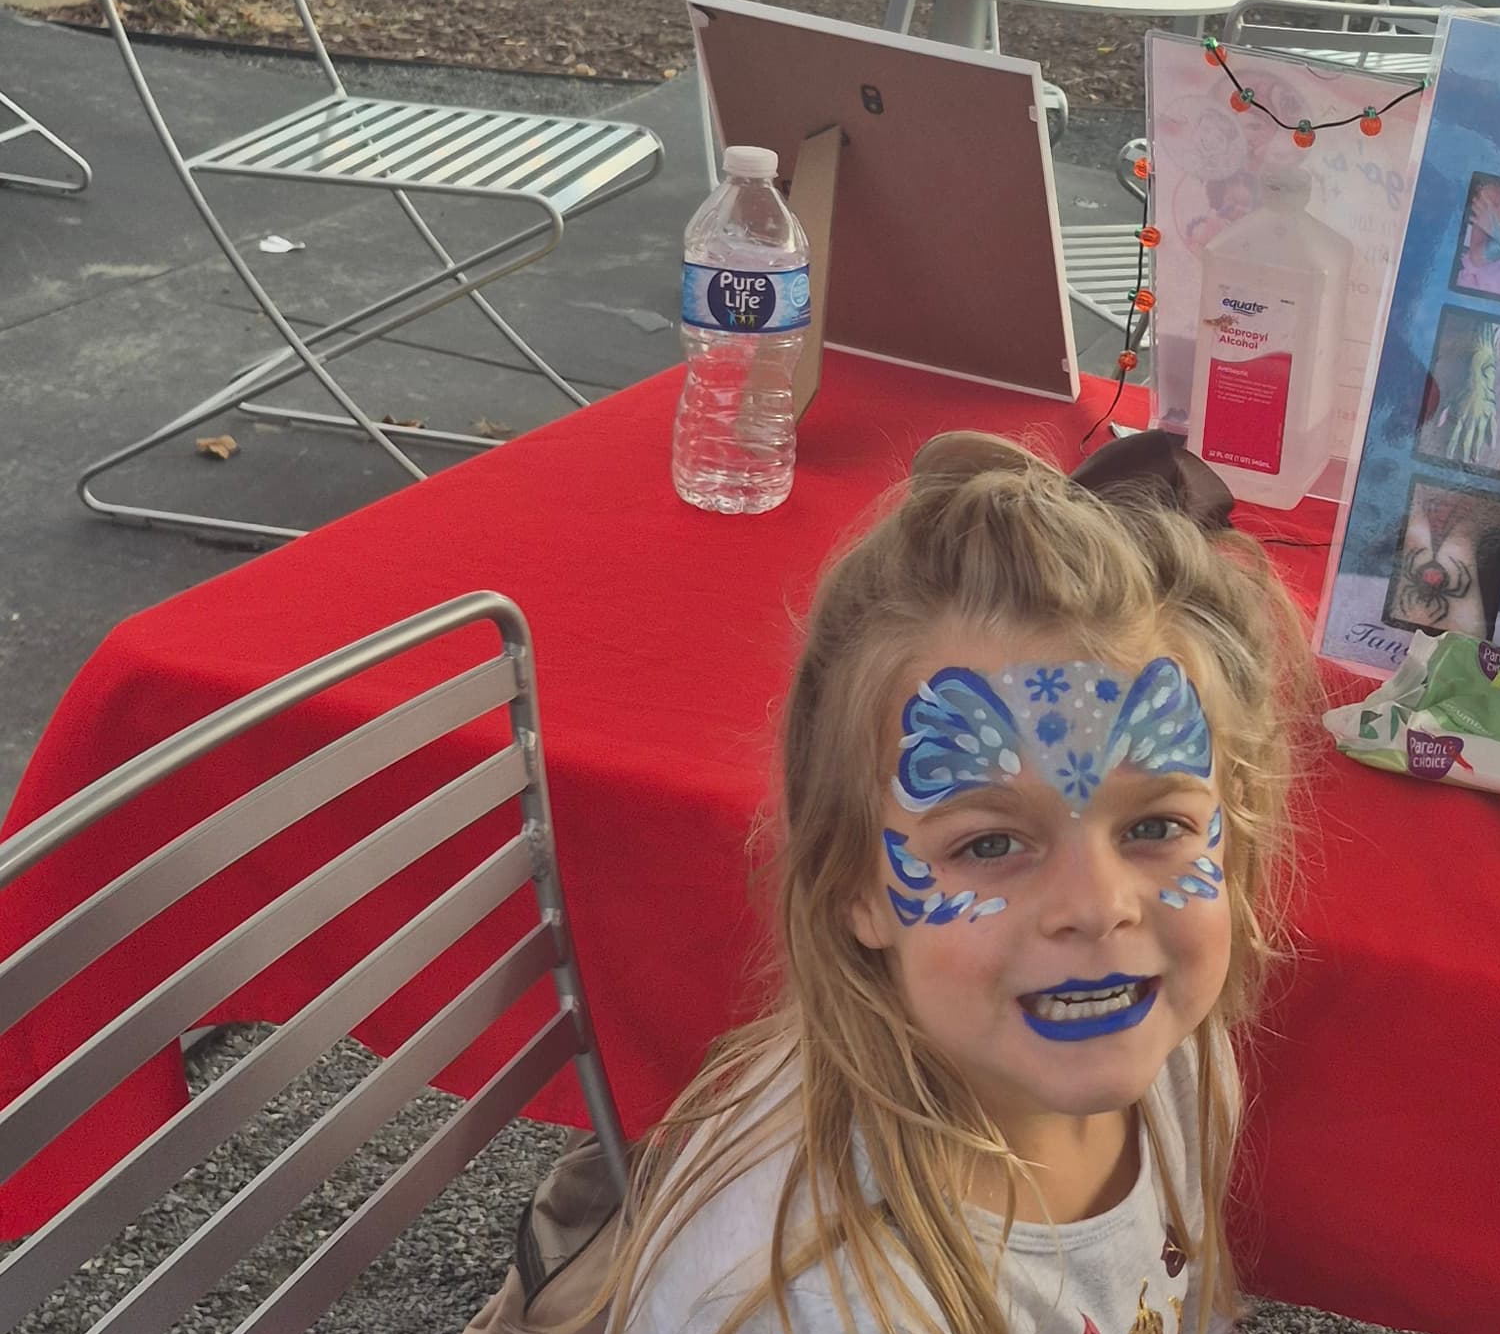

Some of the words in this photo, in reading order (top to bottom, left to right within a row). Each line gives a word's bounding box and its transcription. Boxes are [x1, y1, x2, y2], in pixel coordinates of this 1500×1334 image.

[720, 271, 766, 291] Pure
[724, 290, 760, 312] Life
[1222, 298, 1265, 316] equate
[1219, 335, 1258, 349] Alcohol
[1412, 757, 1447, 768] CHOICE
